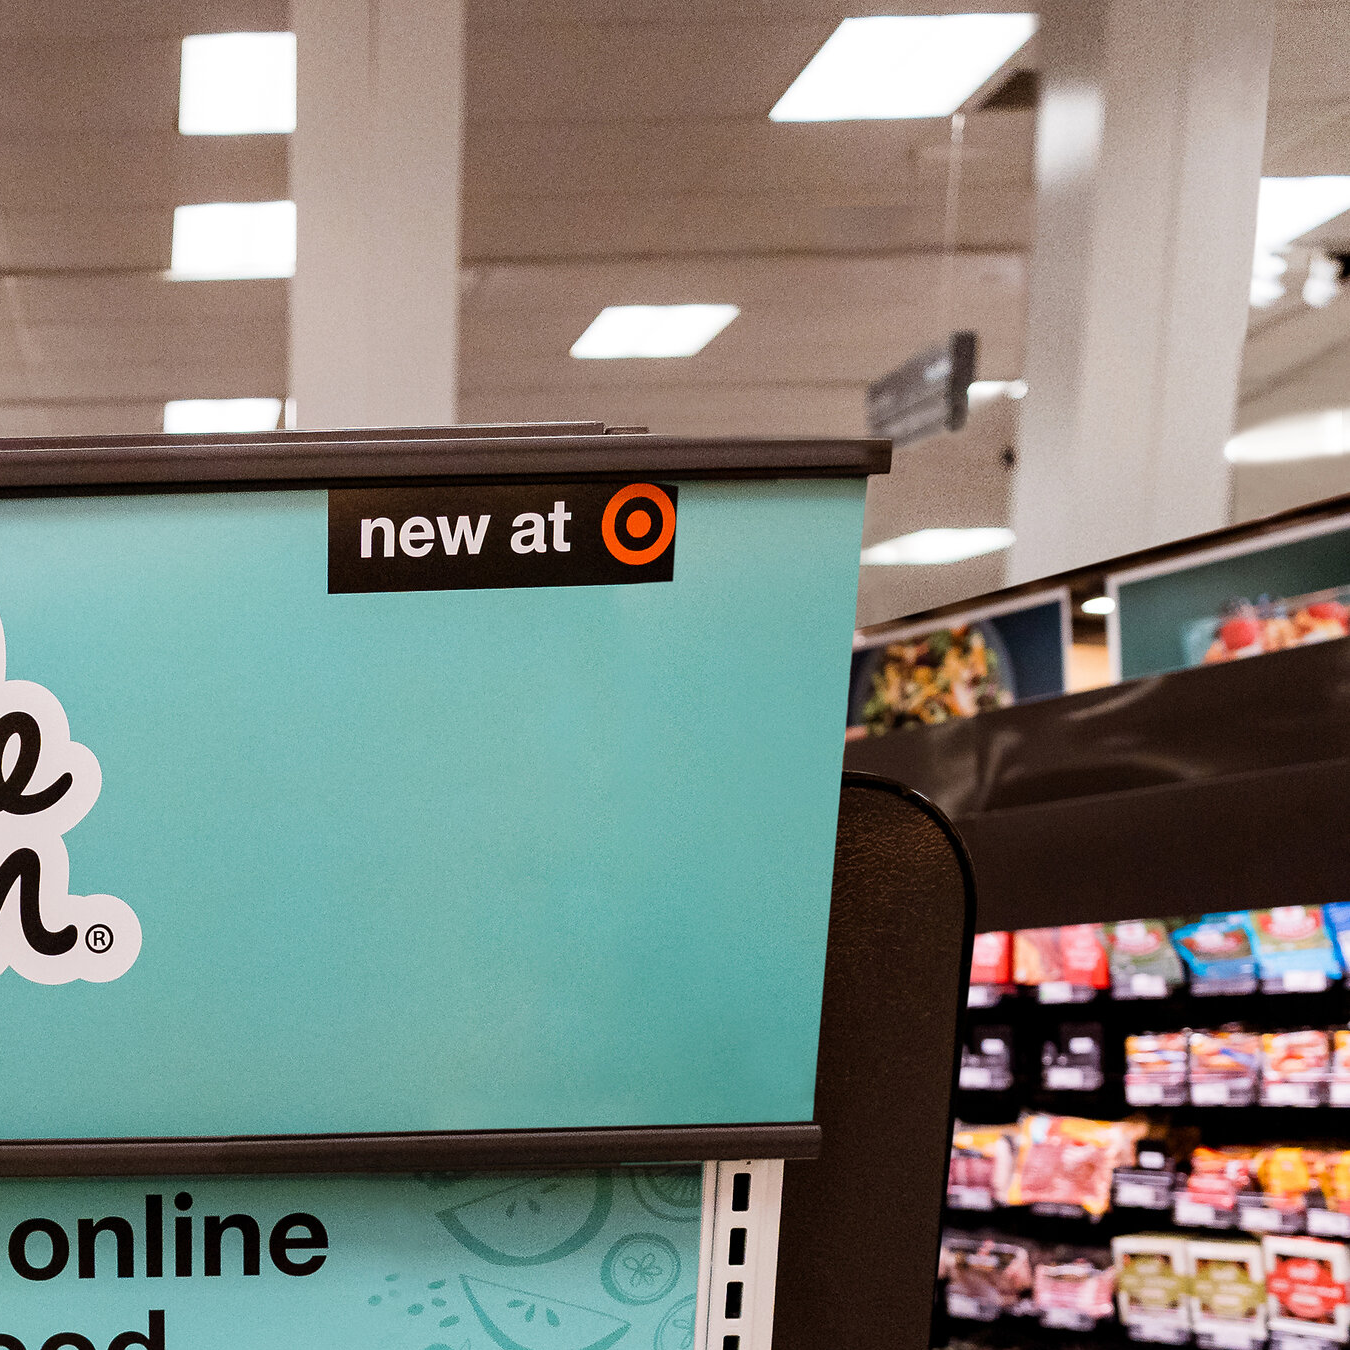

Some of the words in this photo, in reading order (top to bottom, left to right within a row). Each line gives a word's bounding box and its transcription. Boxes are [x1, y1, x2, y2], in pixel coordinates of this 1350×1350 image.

[358, 503, 489, 559] new
[509, 500, 572, 555] at
[6, 1191, 331, 1280] online
